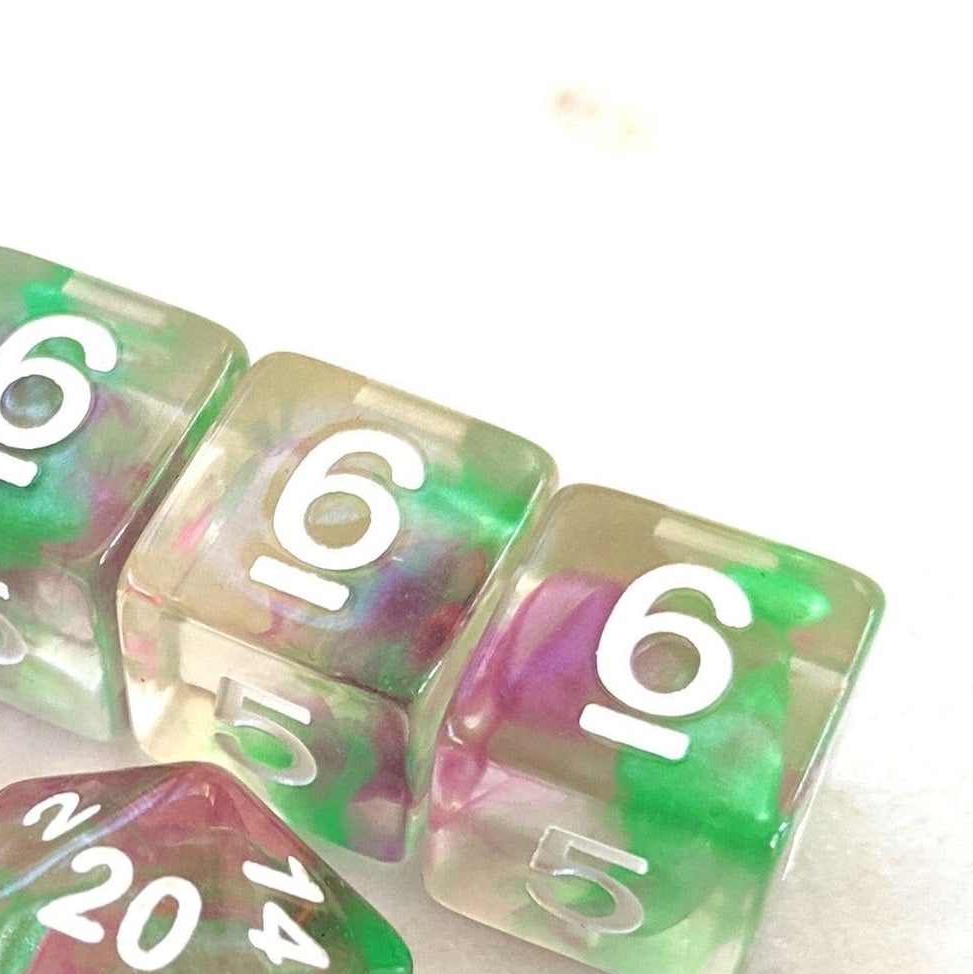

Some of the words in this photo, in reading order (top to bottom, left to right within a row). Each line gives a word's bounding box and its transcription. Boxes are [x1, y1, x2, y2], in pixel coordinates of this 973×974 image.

[249, 429, 425, 611] 6
[579, 563, 754, 760] 6
[214, 676, 317, 786] 5
[22, 791, 101, 841] 2
[37, 846, 203, 972] 20
[242, 856, 329, 969] 14
[526, 824, 649, 934] 5
